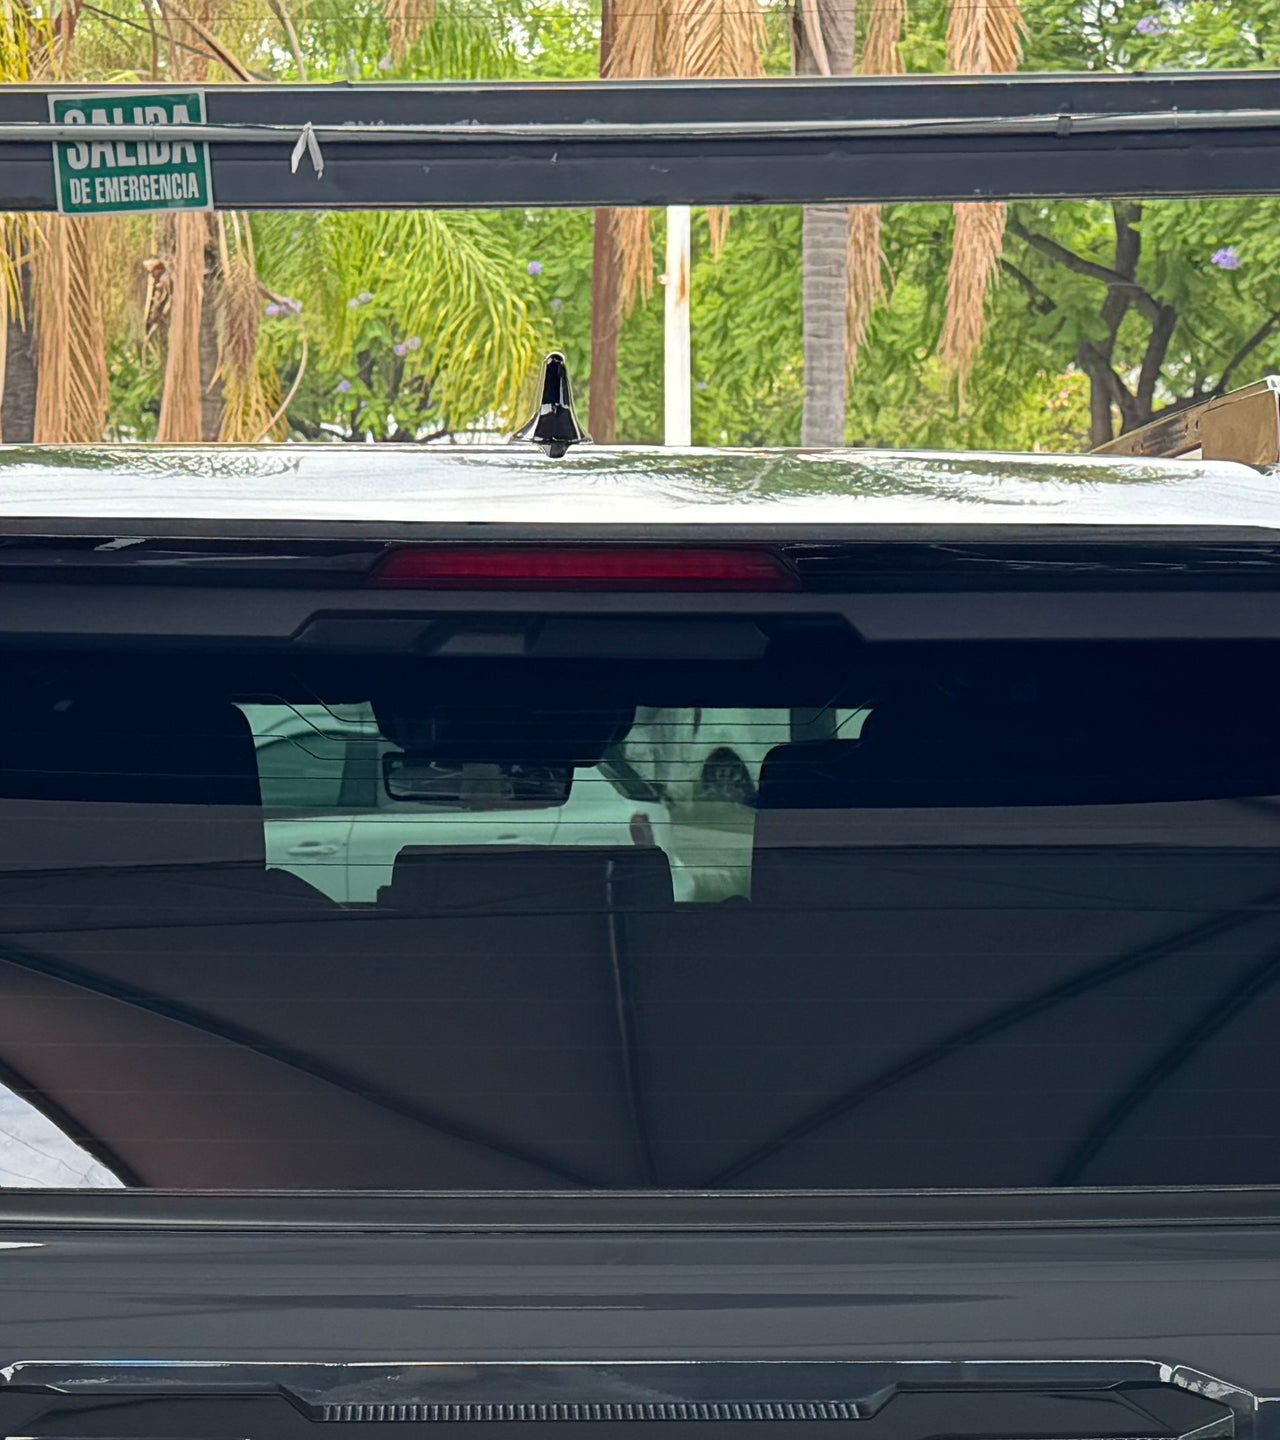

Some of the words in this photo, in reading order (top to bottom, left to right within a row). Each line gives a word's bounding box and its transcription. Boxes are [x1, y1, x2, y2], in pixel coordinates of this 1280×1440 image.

[63, 104, 198, 170] SALIDA
[69, 177, 92, 205] DE
[94, 172, 200, 204] EMERGENCIA
